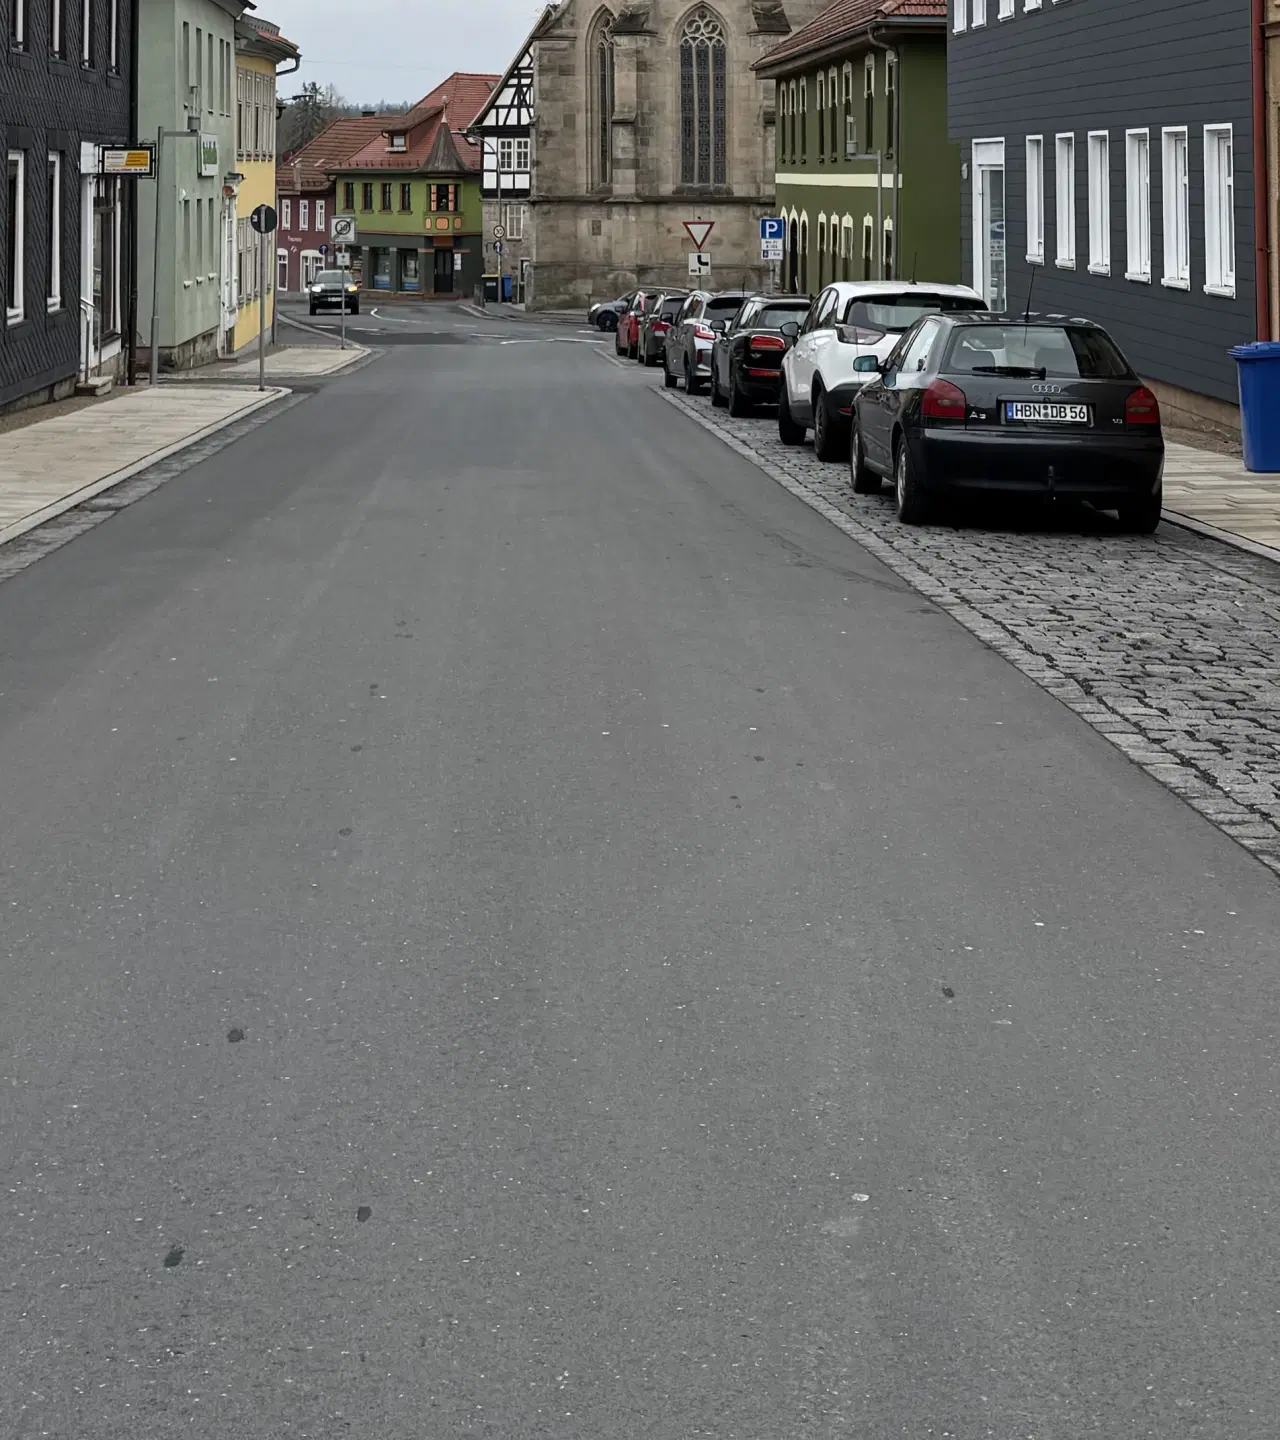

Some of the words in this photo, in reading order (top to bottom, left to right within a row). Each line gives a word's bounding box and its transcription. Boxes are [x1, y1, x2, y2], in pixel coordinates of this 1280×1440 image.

[765, 220, 779, 239] P
[968, 410, 987, 419] A3
[1014, 403, 1042, 419] HBN
[1050, 405, 1067, 419] DB
[1070, 406, 1086, 420] 56
